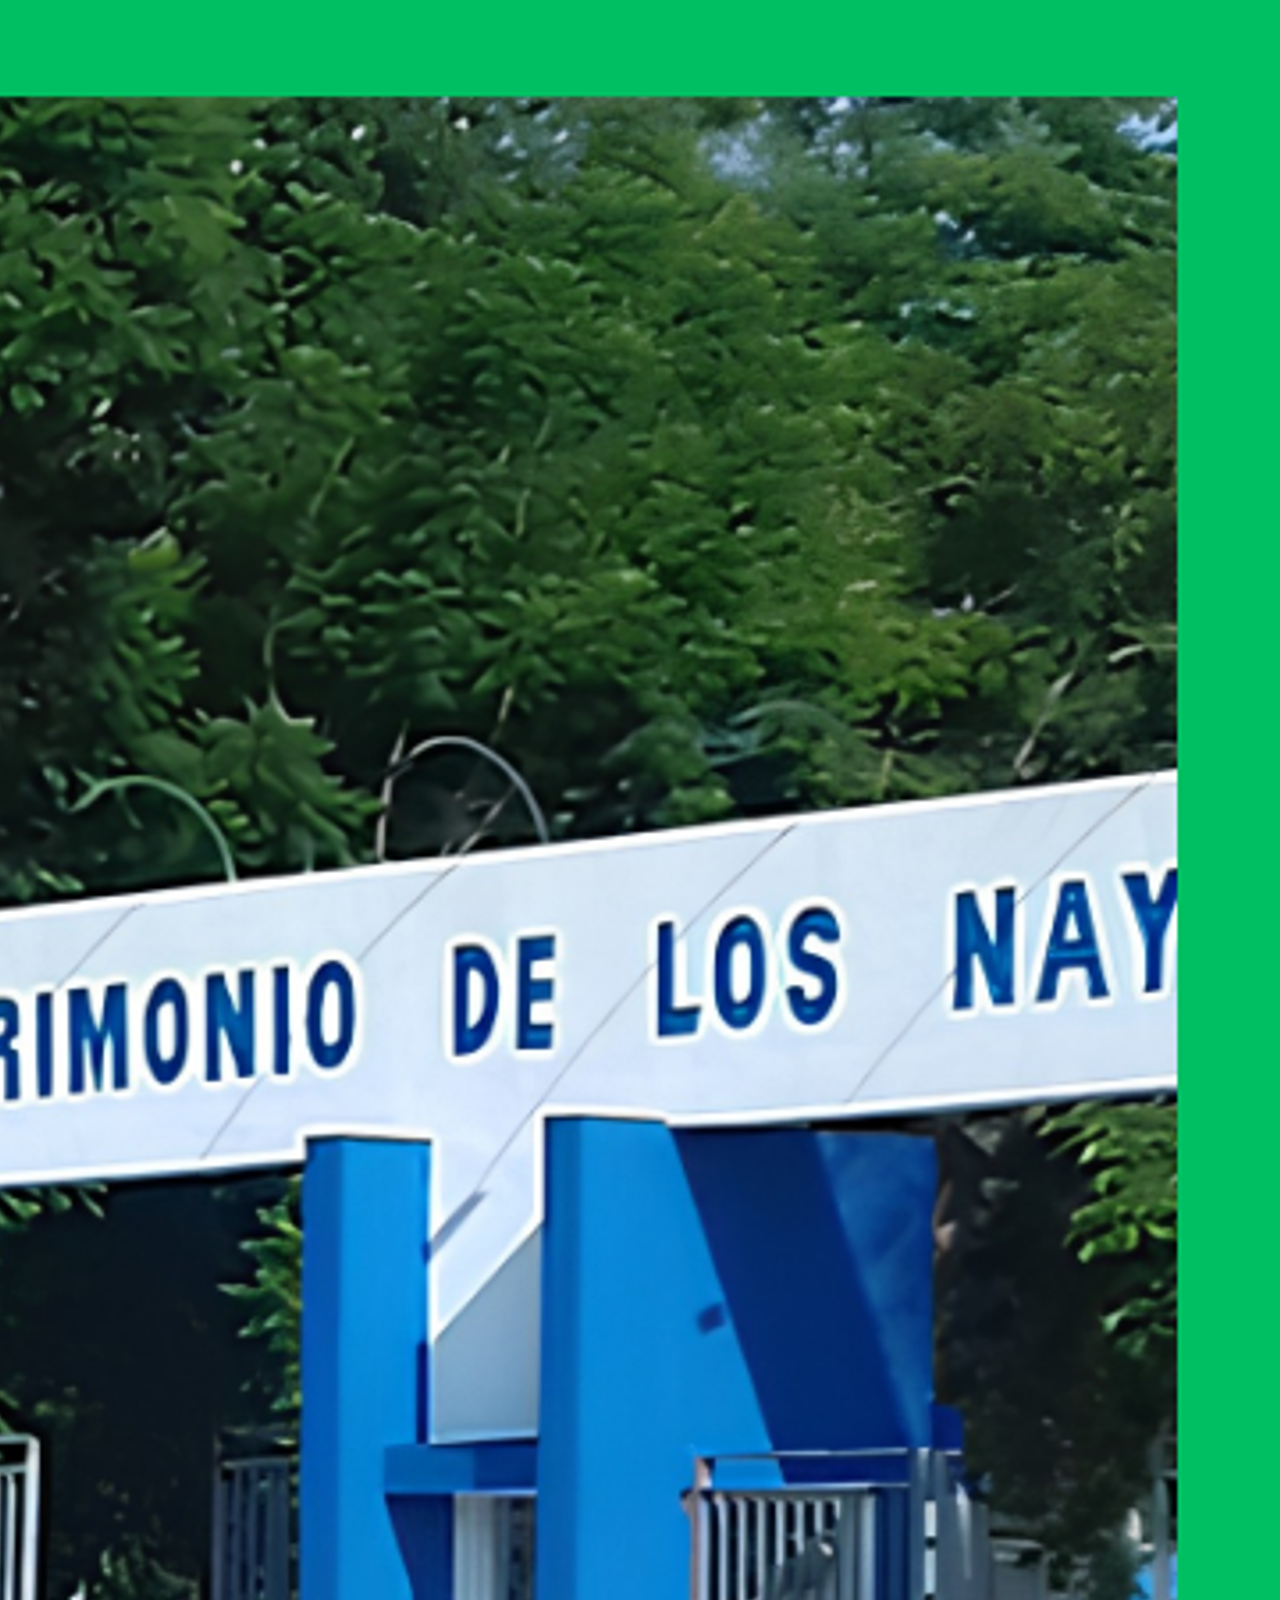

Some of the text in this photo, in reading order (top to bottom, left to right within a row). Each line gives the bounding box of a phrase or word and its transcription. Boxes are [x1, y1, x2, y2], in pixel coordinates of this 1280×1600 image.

[453, 934, 556, 1057] DE
[656, 905, 841, 1038] LOS
[951, 868, 1179, 1011] NAY
